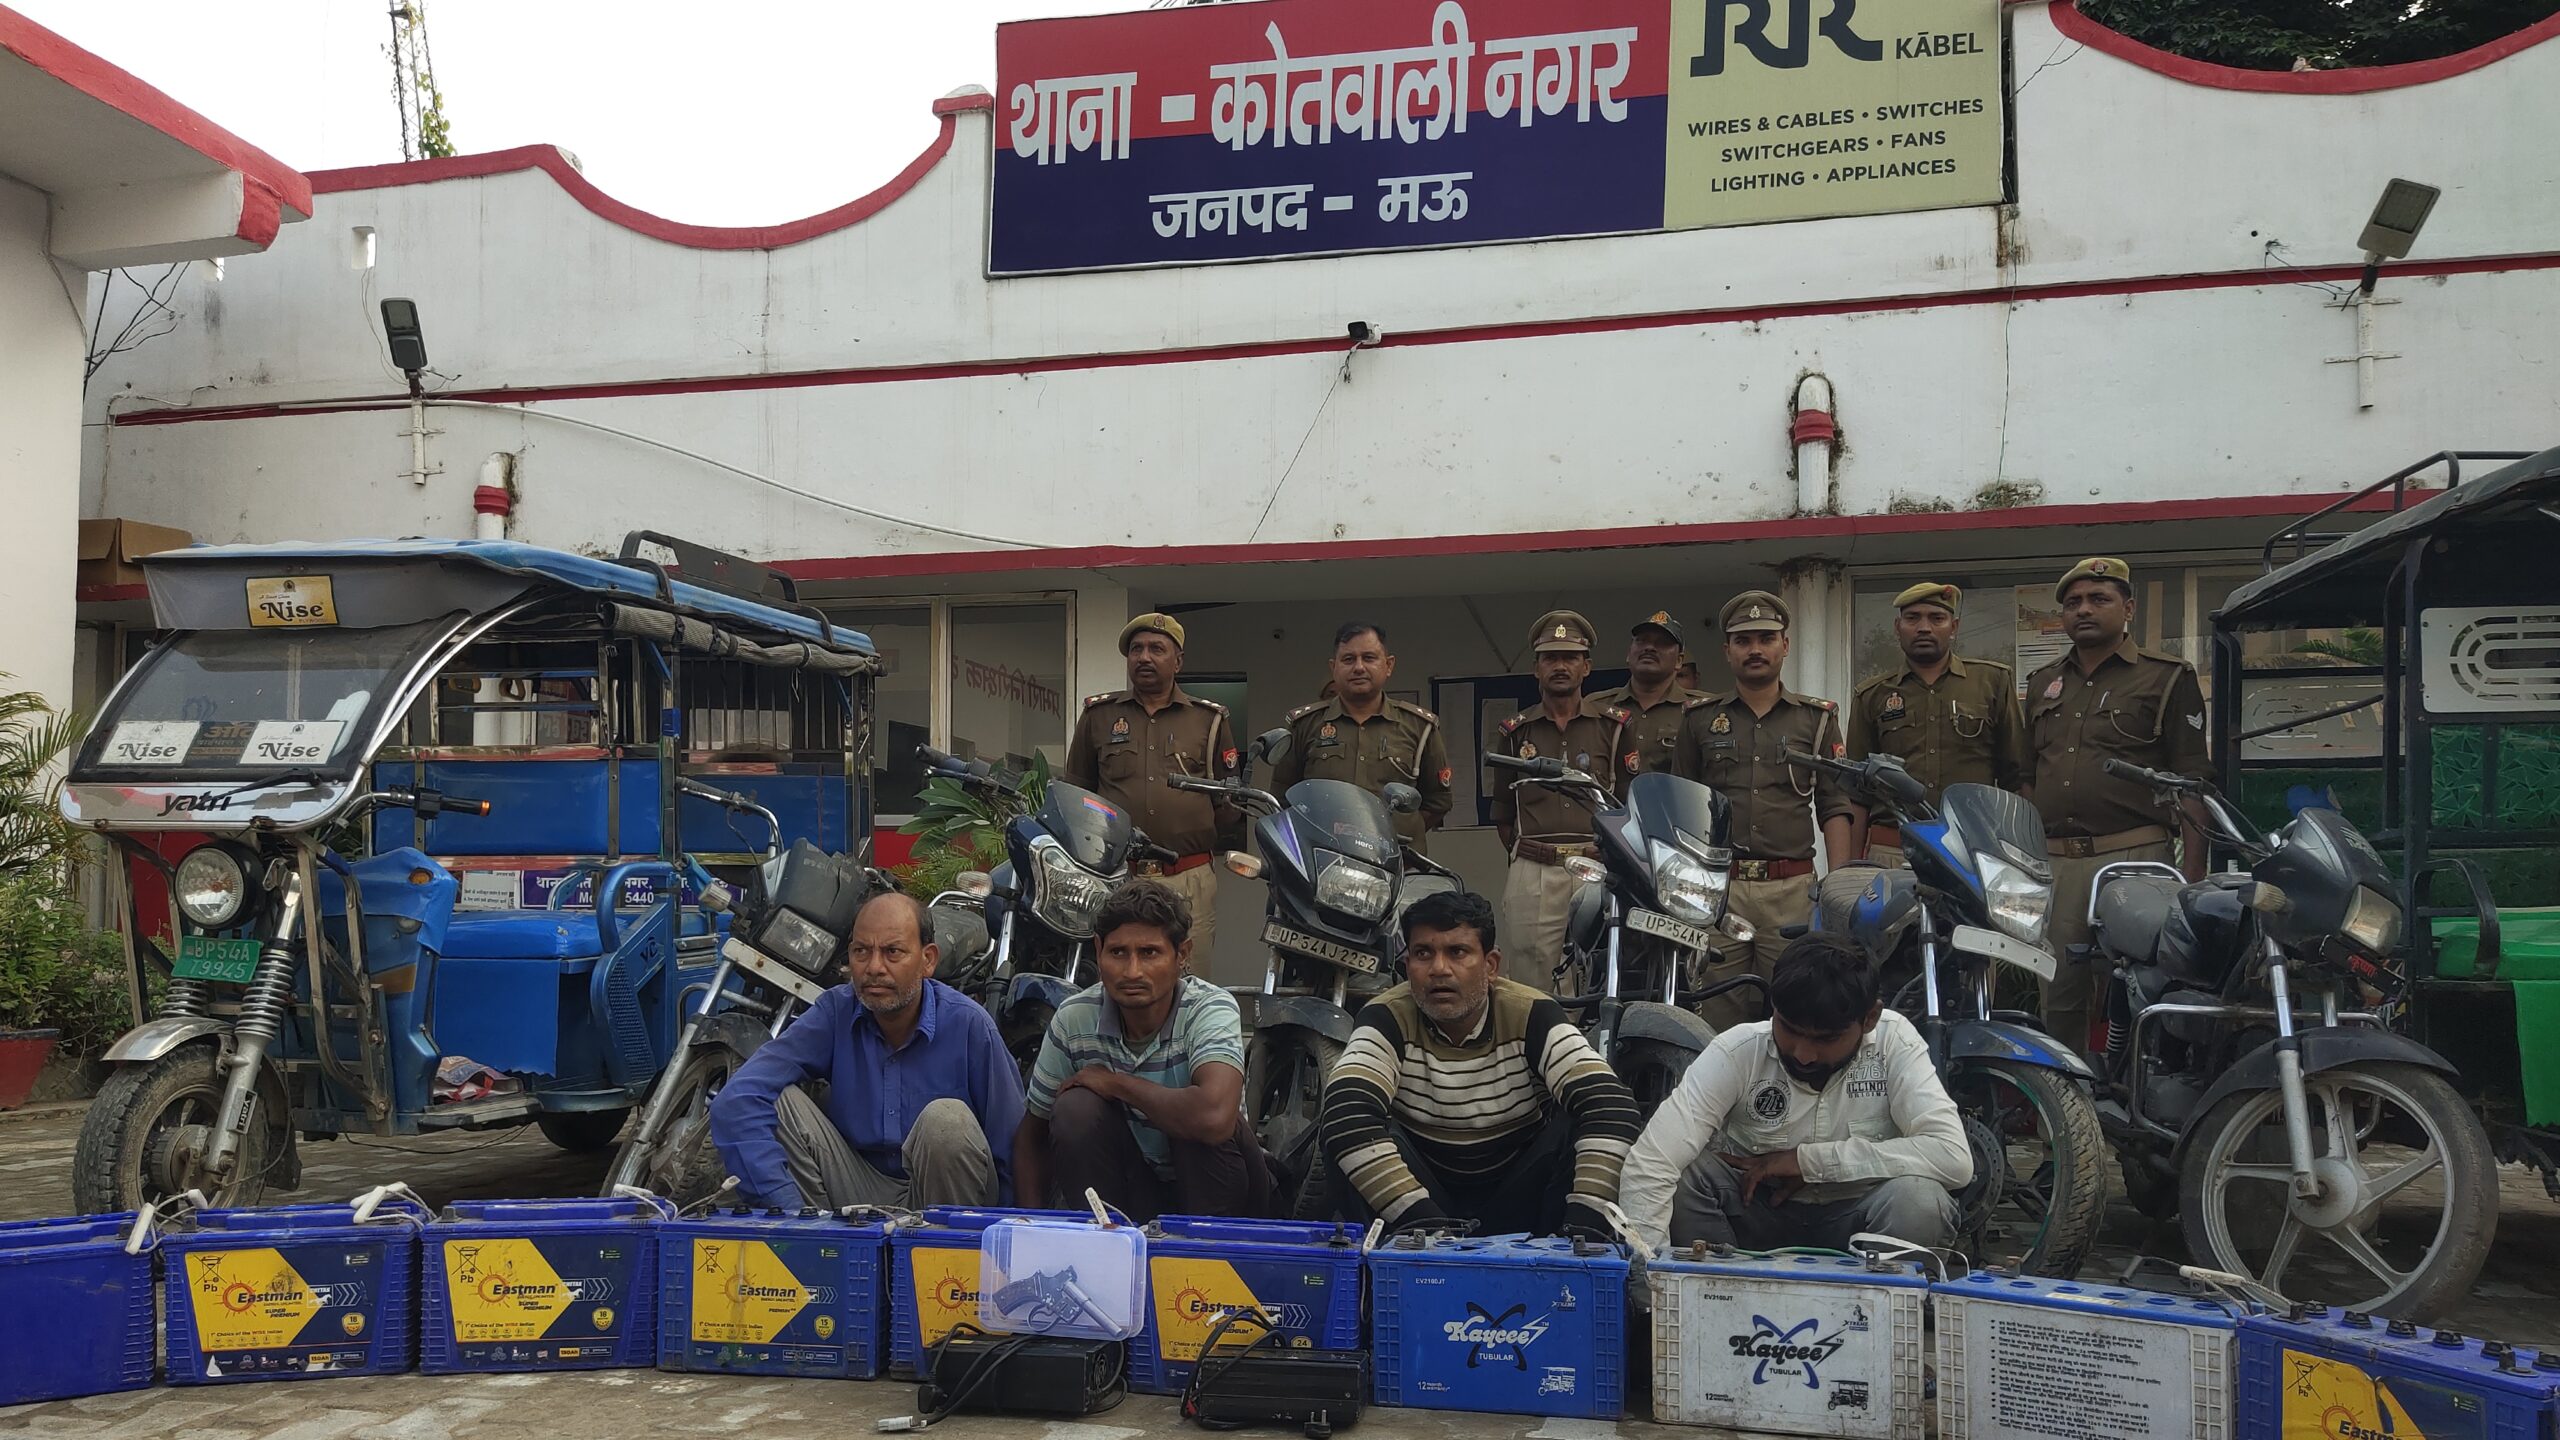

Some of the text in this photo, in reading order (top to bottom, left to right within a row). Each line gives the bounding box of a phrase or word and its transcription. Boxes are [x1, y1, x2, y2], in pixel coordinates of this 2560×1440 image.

[1896, 31, 1984, 59] KĀBEL
[1010, 71, 1138, 165] थाना
[1209, 0, 1475, 152] कोतवाली
[1484, 26, 1640, 129] नगर
[1688, 98, 1984, 137] WIRES & CABLES SWITCHES
[1721, 130, 1946, 163] SWITCHGEARS FANS
[1711, 158, 1956, 193] LIGHTING APPLIANCES
[1149, 184, 1314, 241] जनपद
[1378, 172, 1473, 225] मऊ
[260, 601, 324, 622] Nise
[118, 742, 177, 760] Nise
[258, 742, 321, 760] Nise
[157, 791, 232, 817] yatri
[204, 1284, 218, 1292] Pb
[460, 1275, 474, 1283] Pb
[238, 1291, 303, 1303] Eastman
[492, 1284, 556, 1295] Eastman
[738, 1285, 797, 1298] Eastman
[1444, 1315, 1531, 1348] Kaycee
[1478, 1352, 1514, 1361] TUBULAR
[1729, 1330, 1823, 1364] Kaycee
[1769, 1367, 1802, 1376] TUBULAR
[2339, 1420, 2402, 1440] Eastm
